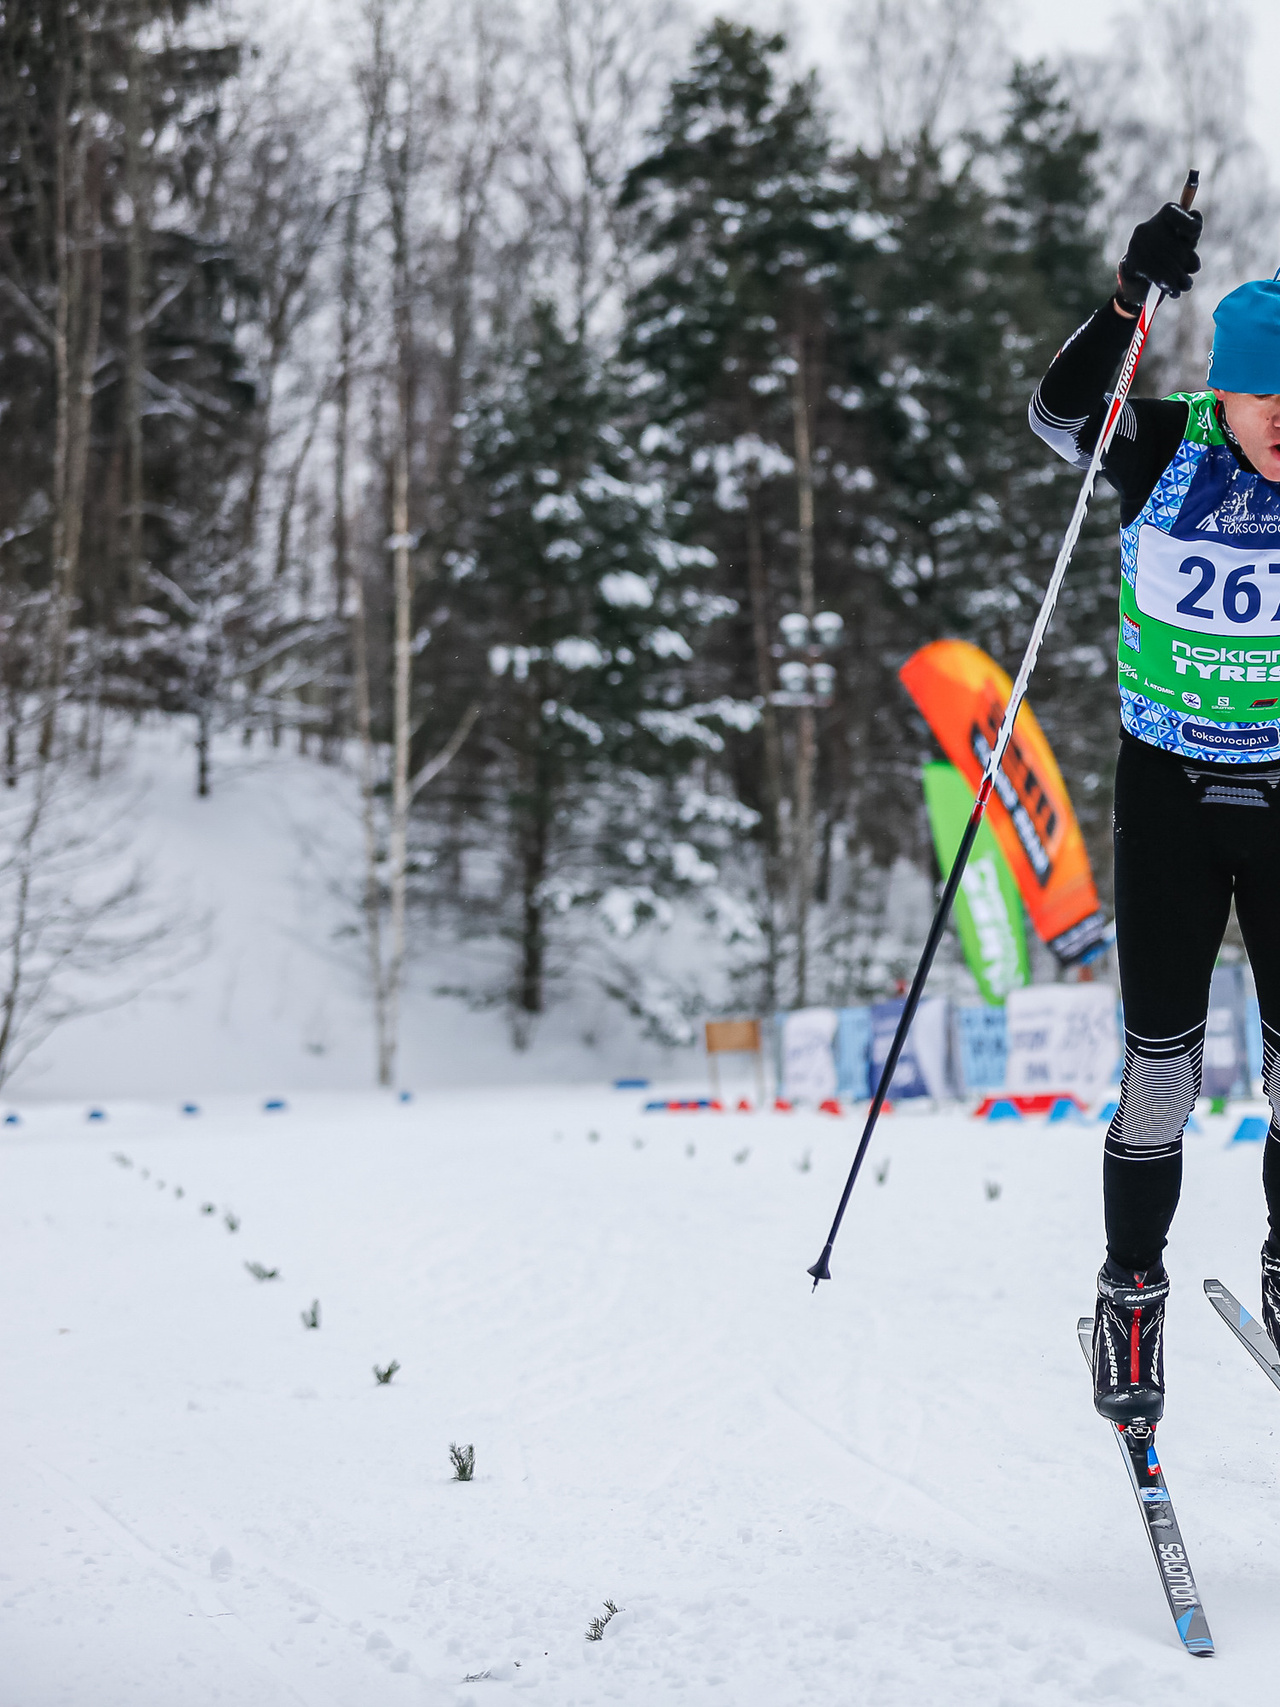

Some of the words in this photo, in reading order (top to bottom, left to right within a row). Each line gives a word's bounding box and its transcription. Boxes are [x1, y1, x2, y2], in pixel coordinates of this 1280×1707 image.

[1116, 327, 1146, 403] MADSHUS
[1149, 683, 1176, 696] ATOMIC
[1192, 728, 1270, 747] toksovocup.ru
[1102, 1313, 1118, 1387] MADSHUS
